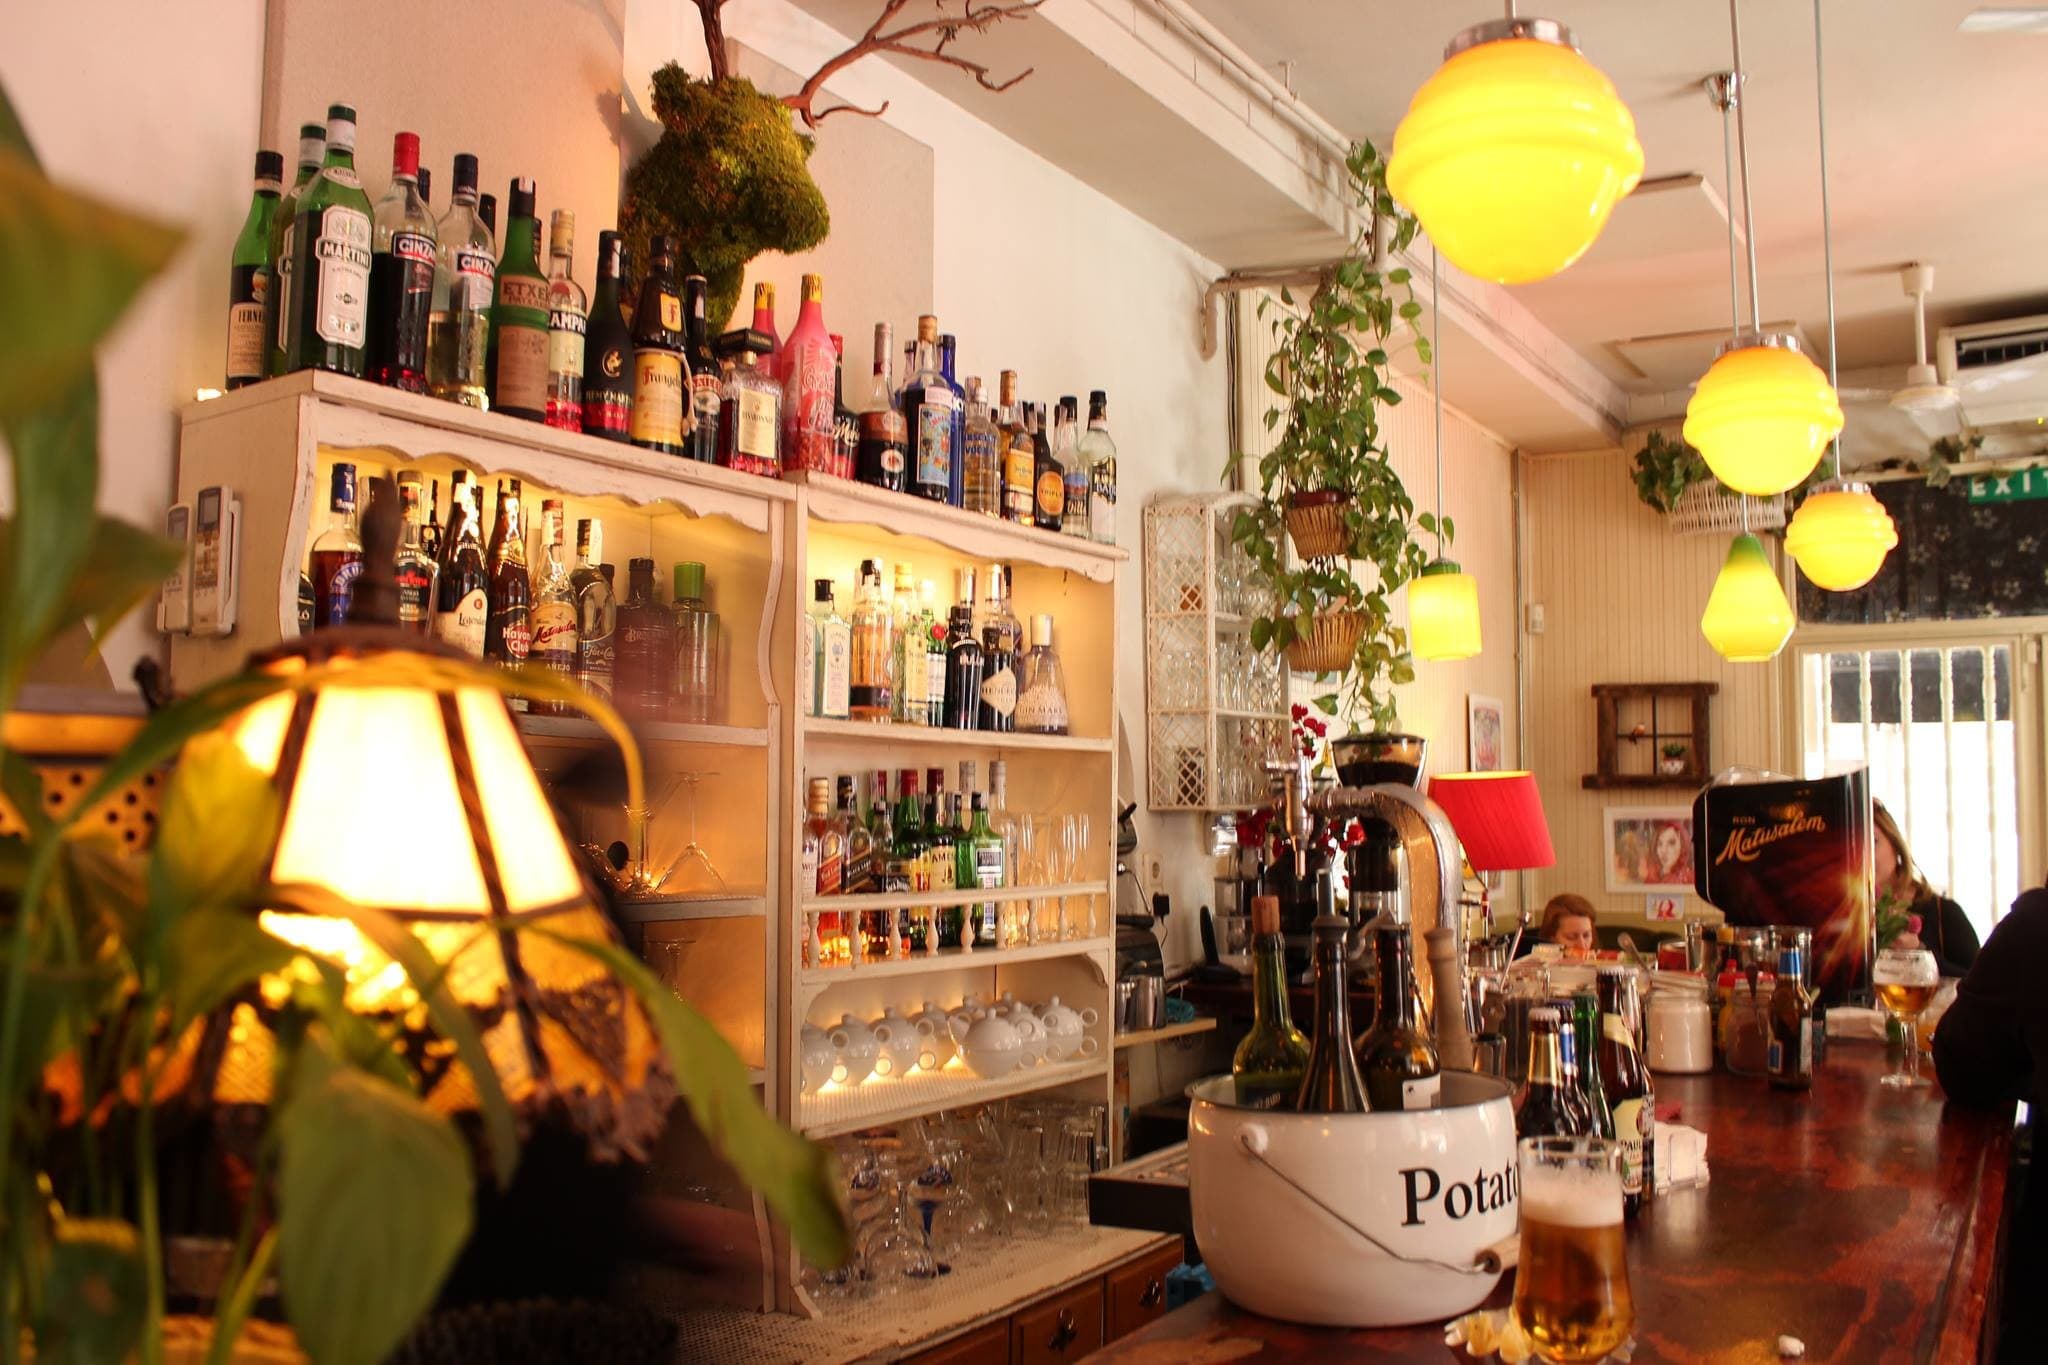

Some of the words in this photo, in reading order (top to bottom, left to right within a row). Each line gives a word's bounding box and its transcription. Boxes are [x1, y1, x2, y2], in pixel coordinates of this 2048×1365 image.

[321, 241, 370, 268] MARTINI
[1019, 705, 1035, 714] GIN
[1733, 815, 1756, 825] RON
[1715, 811, 1826, 866] Matusalem
